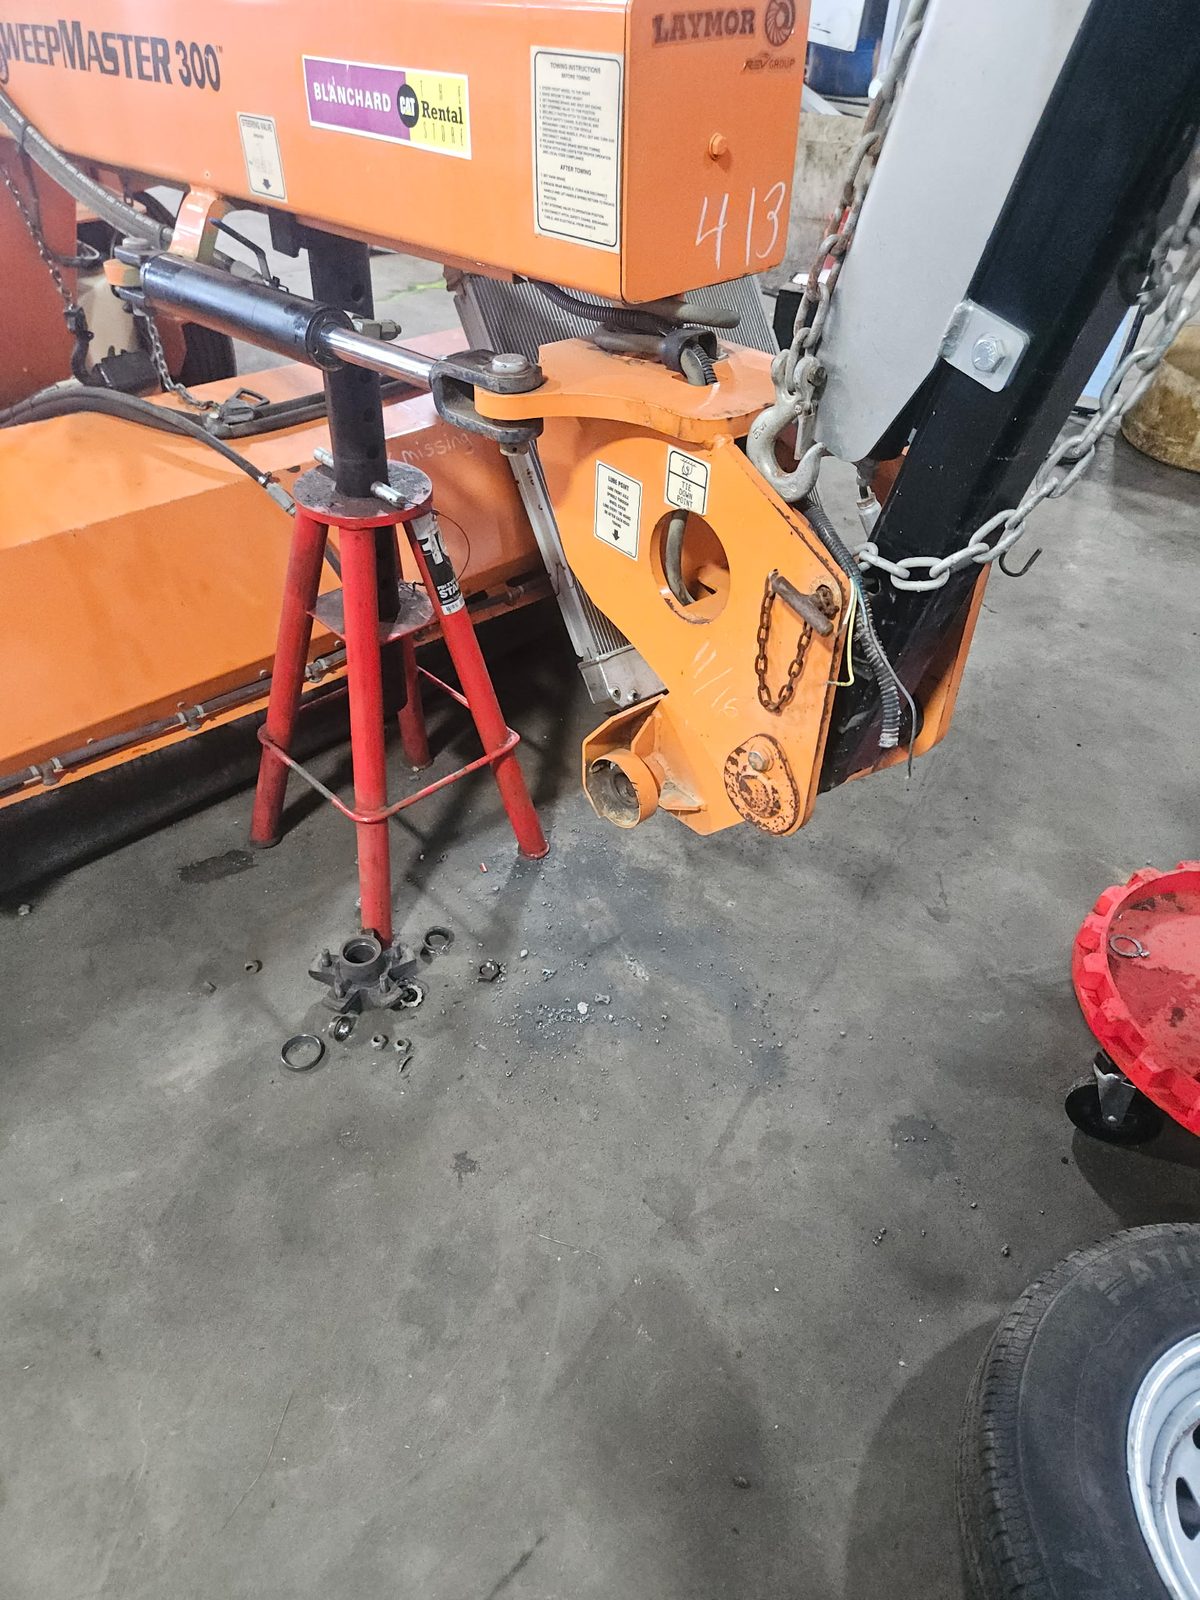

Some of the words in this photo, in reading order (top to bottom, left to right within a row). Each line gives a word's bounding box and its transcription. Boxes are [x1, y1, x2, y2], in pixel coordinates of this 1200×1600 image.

[652, 8, 756, 44] LAYMOR
[550, 62, 568, 72] TOWING
[568, 64, 601, 75] INSTRUCTIONS
[313, 81, 392, 113] BLANCHARD
[399, 96, 416, 117] CAT
[420, 100, 464, 125] Rental
[423, 121, 464, 147] STORE
[560, 164, 574, 173] AFTER
[574, 166, 592, 176] TOWING
[401, 432, 475, 464] missing
[618, 481, 629, 492] POINT
[678, 488, 693, 501] DOWN
[681, 481, 692, 492] TIE
[676, 495, 693, 508] POINT
